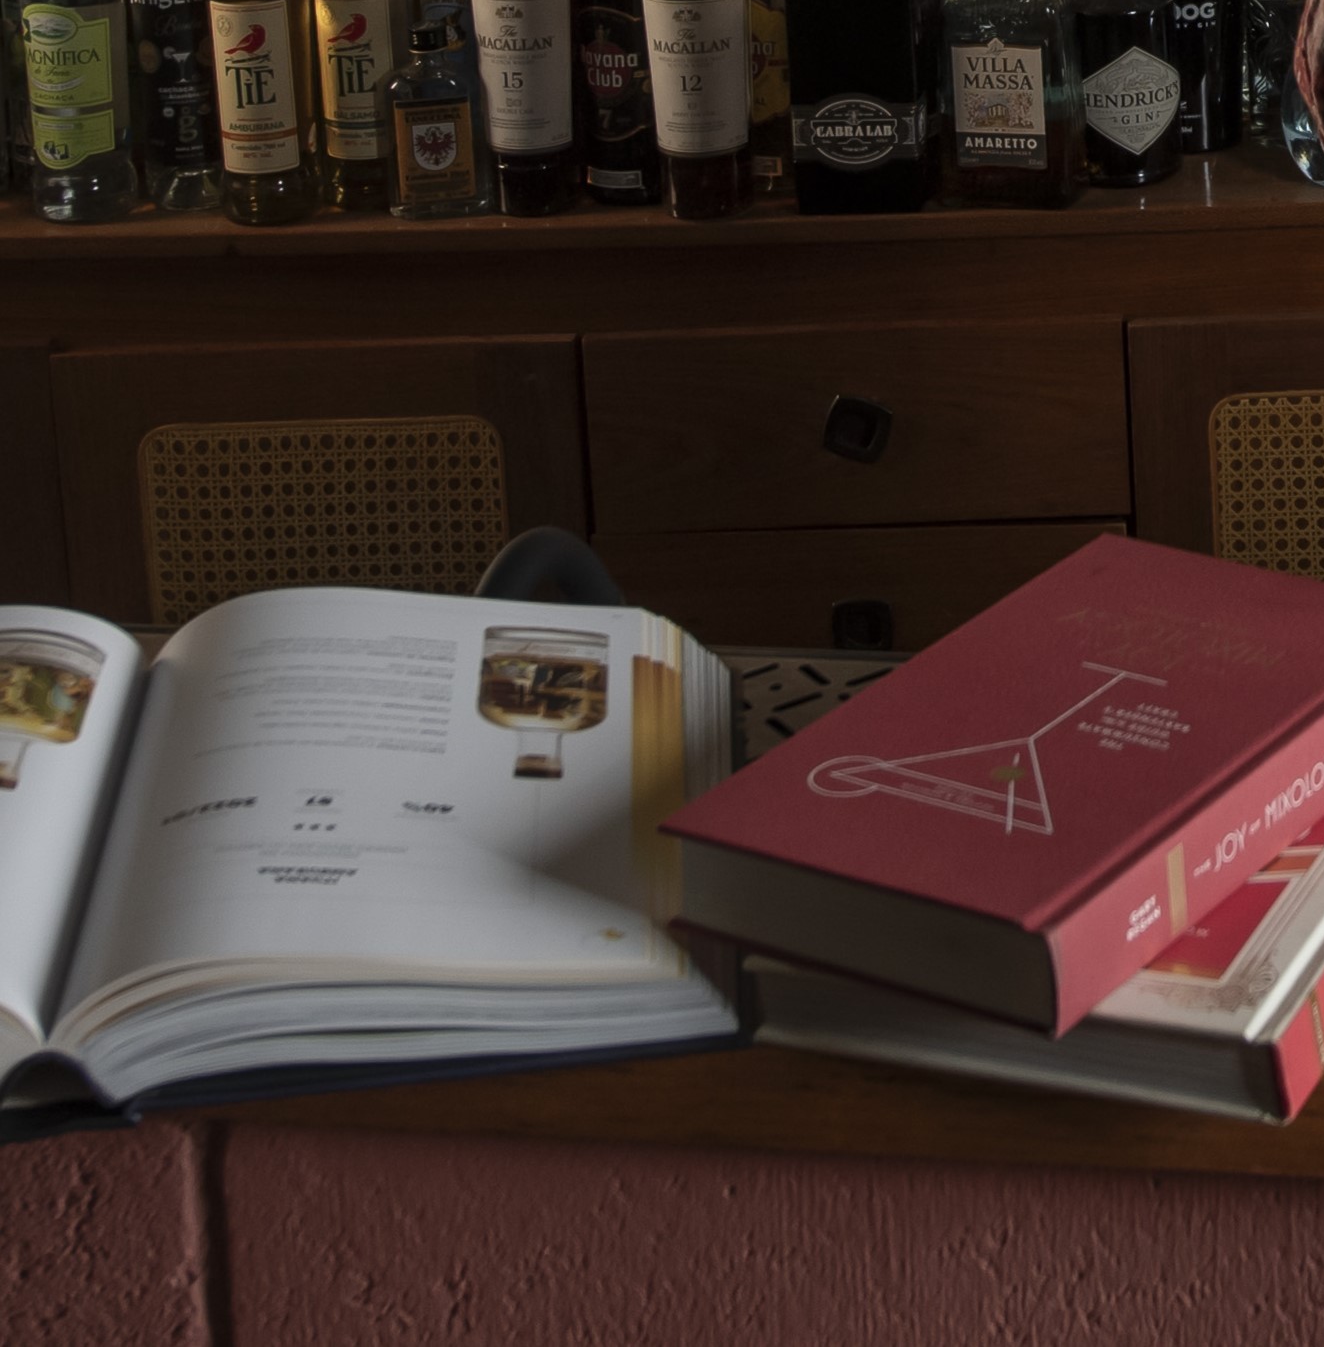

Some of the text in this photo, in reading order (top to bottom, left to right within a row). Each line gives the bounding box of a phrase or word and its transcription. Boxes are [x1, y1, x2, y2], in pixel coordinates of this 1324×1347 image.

[478, 35, 555, 52] MACALLAN
[652, 37, 731, 53] MACALLAN
[27, 46, 101, 66] AGNÍFICA
[582, 47, 638, 67] avana
[965, 57, 1027, 74] VILLA
[501, 70, 525, 90] 15
[587, 68, 624, 88] Club
[679, 73, 705, 92] 12
[963, 73, 1032, 91] MASSA
[1083, 81, 1181, 110] HENDRICK'S
[1121, 111, 1154, 125] GIN
[964, 134, 1037, 151] AMARETTO
[1213, 822, 1248, 874] JOY
